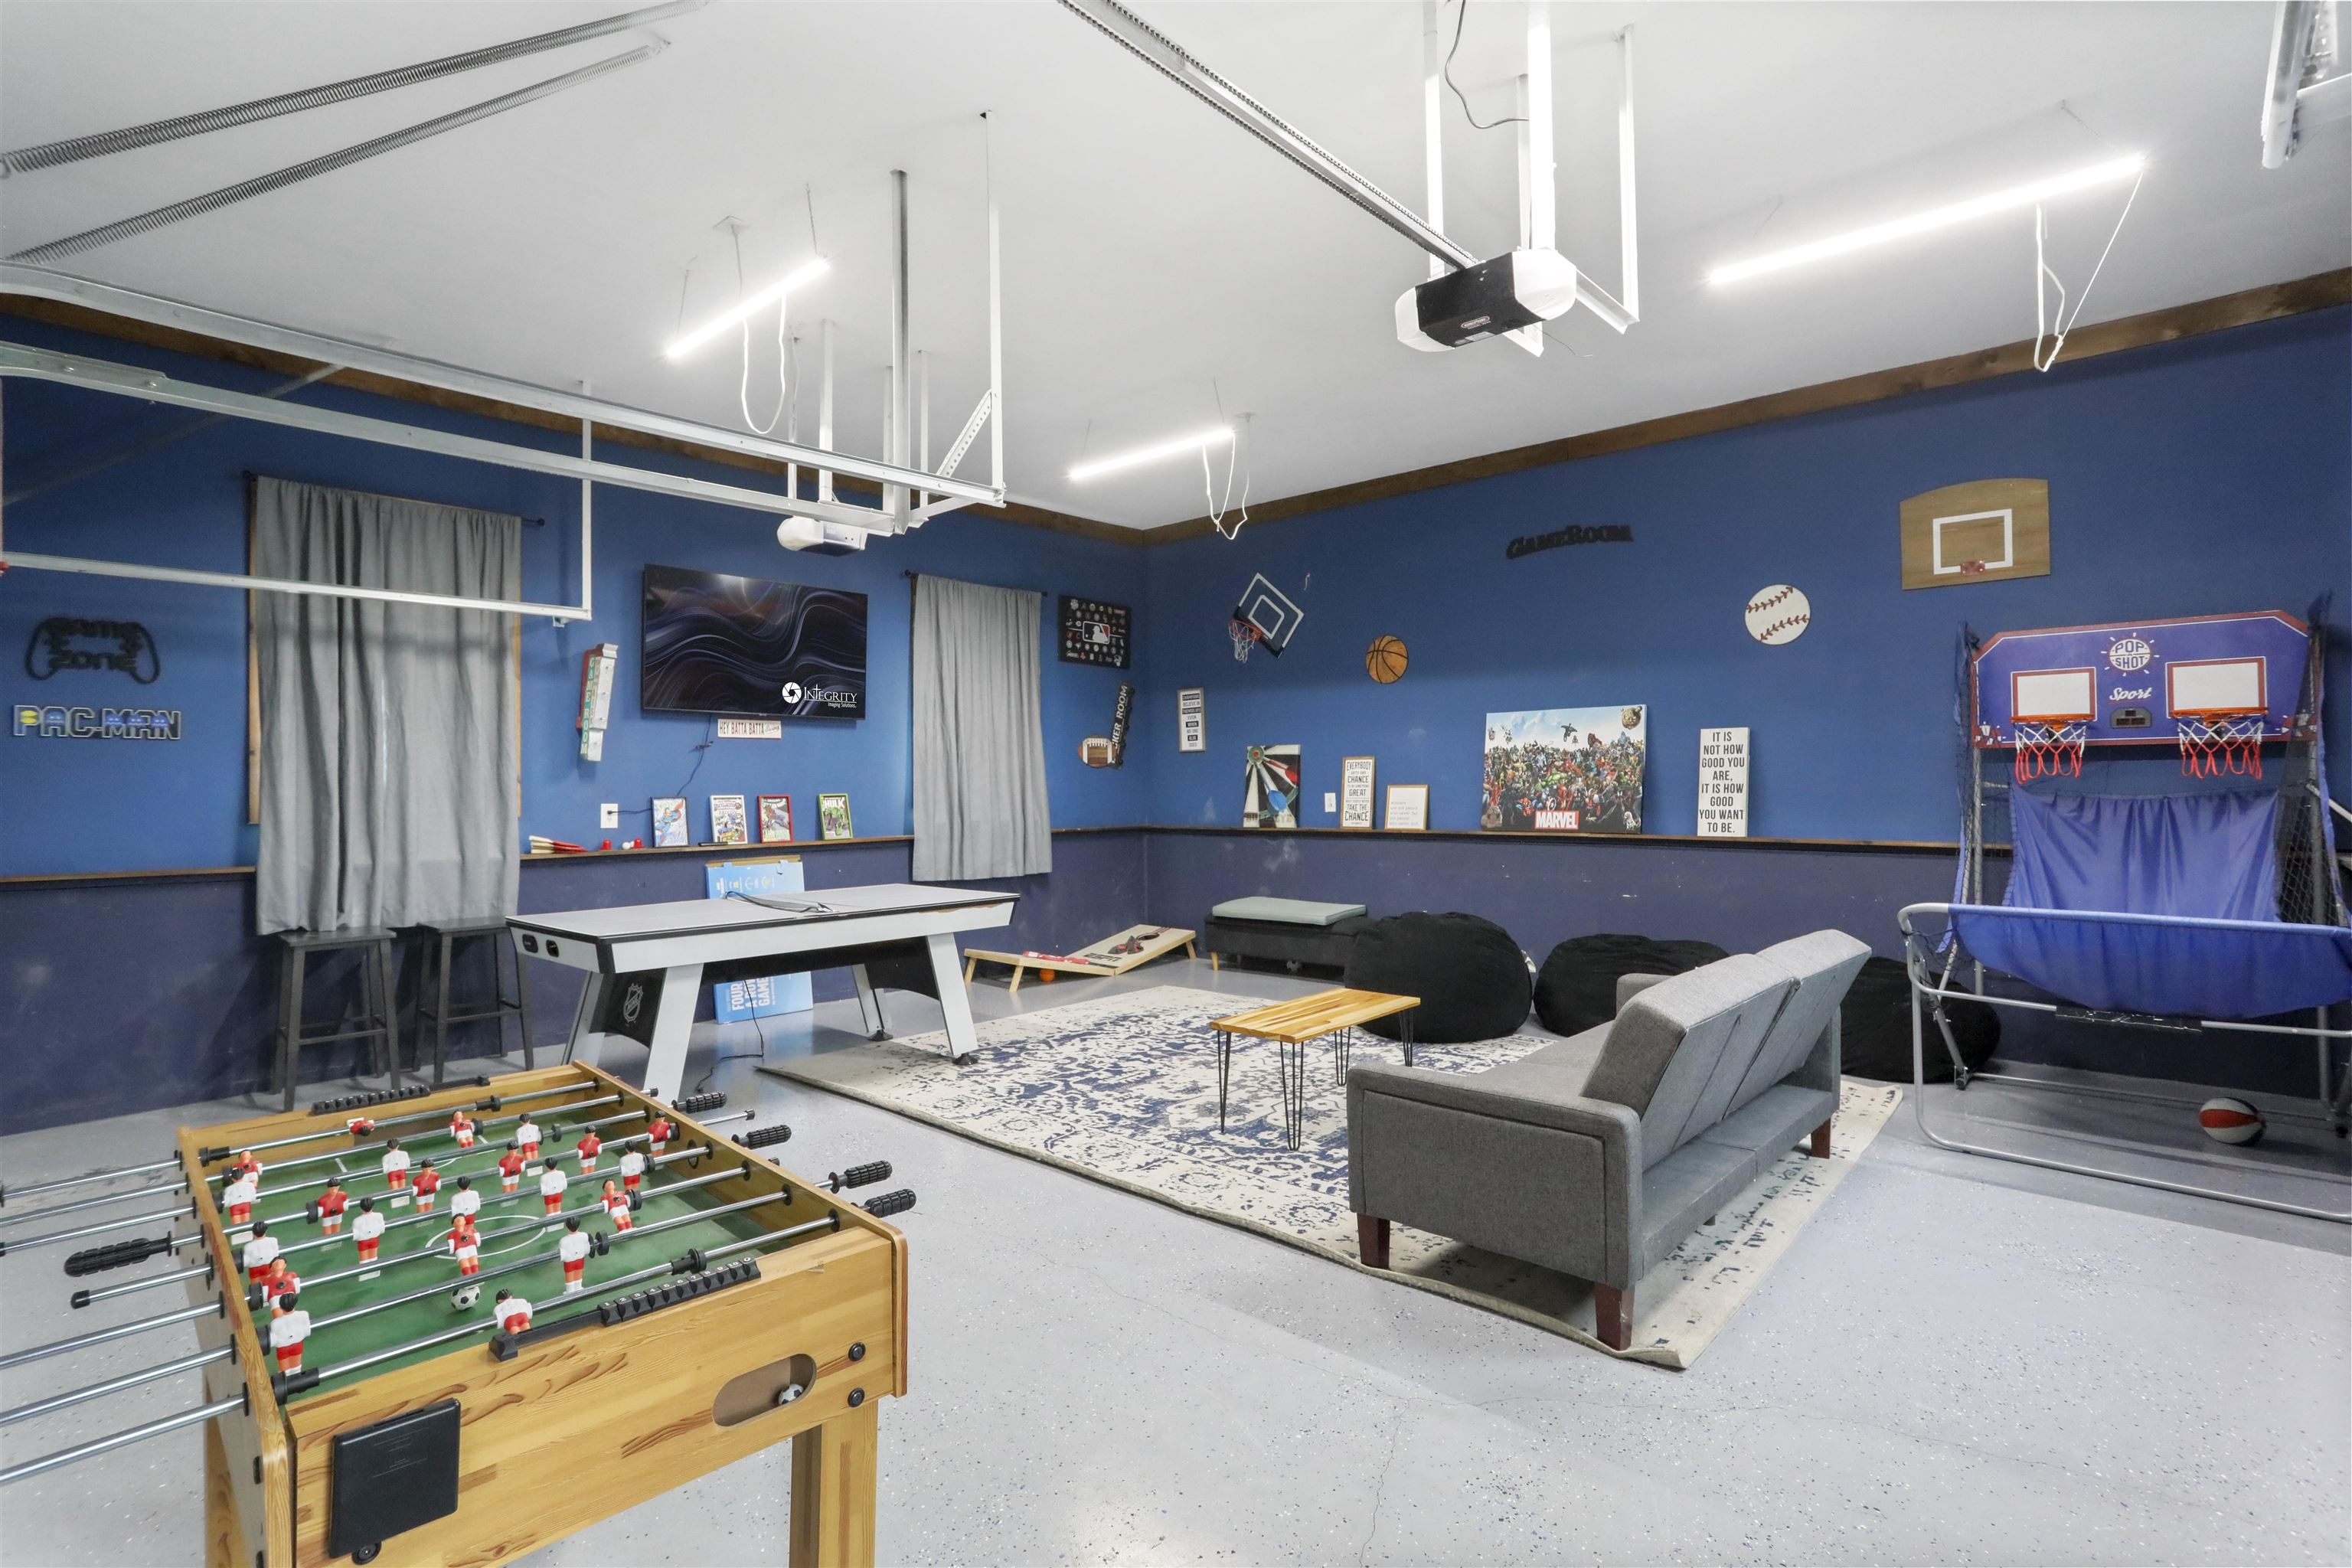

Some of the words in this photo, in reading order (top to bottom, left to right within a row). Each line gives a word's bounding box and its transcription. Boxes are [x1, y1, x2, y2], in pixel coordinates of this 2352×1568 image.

[2115, 640, 2145, 654] POP
[2115, 655, 2145, 668] SHOT
[2109, 688, 2152, 701] Sport
[1116, 685, 1128, 719] ROOM
[14, 705, 181, 740] PAC-MAN
[720, 722, 729, 734] HEY
[731, 722, 747, 735] BATTA
[750, 722, 765, 735] BATTA
[1713, 732, 1720, 742] IT
[1723, 731, 1732, 742] IS
[1704, 745, 1720, 755] NOT
[1723, 744, 1743, 754] HOW
[1347, 761, 1371, 770] EVERYBODY
[1702, 757, 1724, 768] GOOD
[1728, 757, 1745, 767] YOU
[1713, 770, 1733, 782] ARE,
[1349, 789, 1366, 797] GREAT
[1702, 784, 1709, 793] IT
[1713, 784, 1720, 793] IS
[1723, 783, 1743, 793] HOW
[824, 797, 845, 809] HULK
[1710, 796, 1733, 806] GOOD
[1344, 812, 1369, 821] CHANCE
[1700, 810, 1716, 819] YOU
[1719, 809, 1743, 819] WANT
[1535, 812, 1577, 828] MARVEL
[1707, 822, 1718, 832] TO
[1721, 822, 1735, 833] BE.
[730, 983, 744, 1011] FOUR
